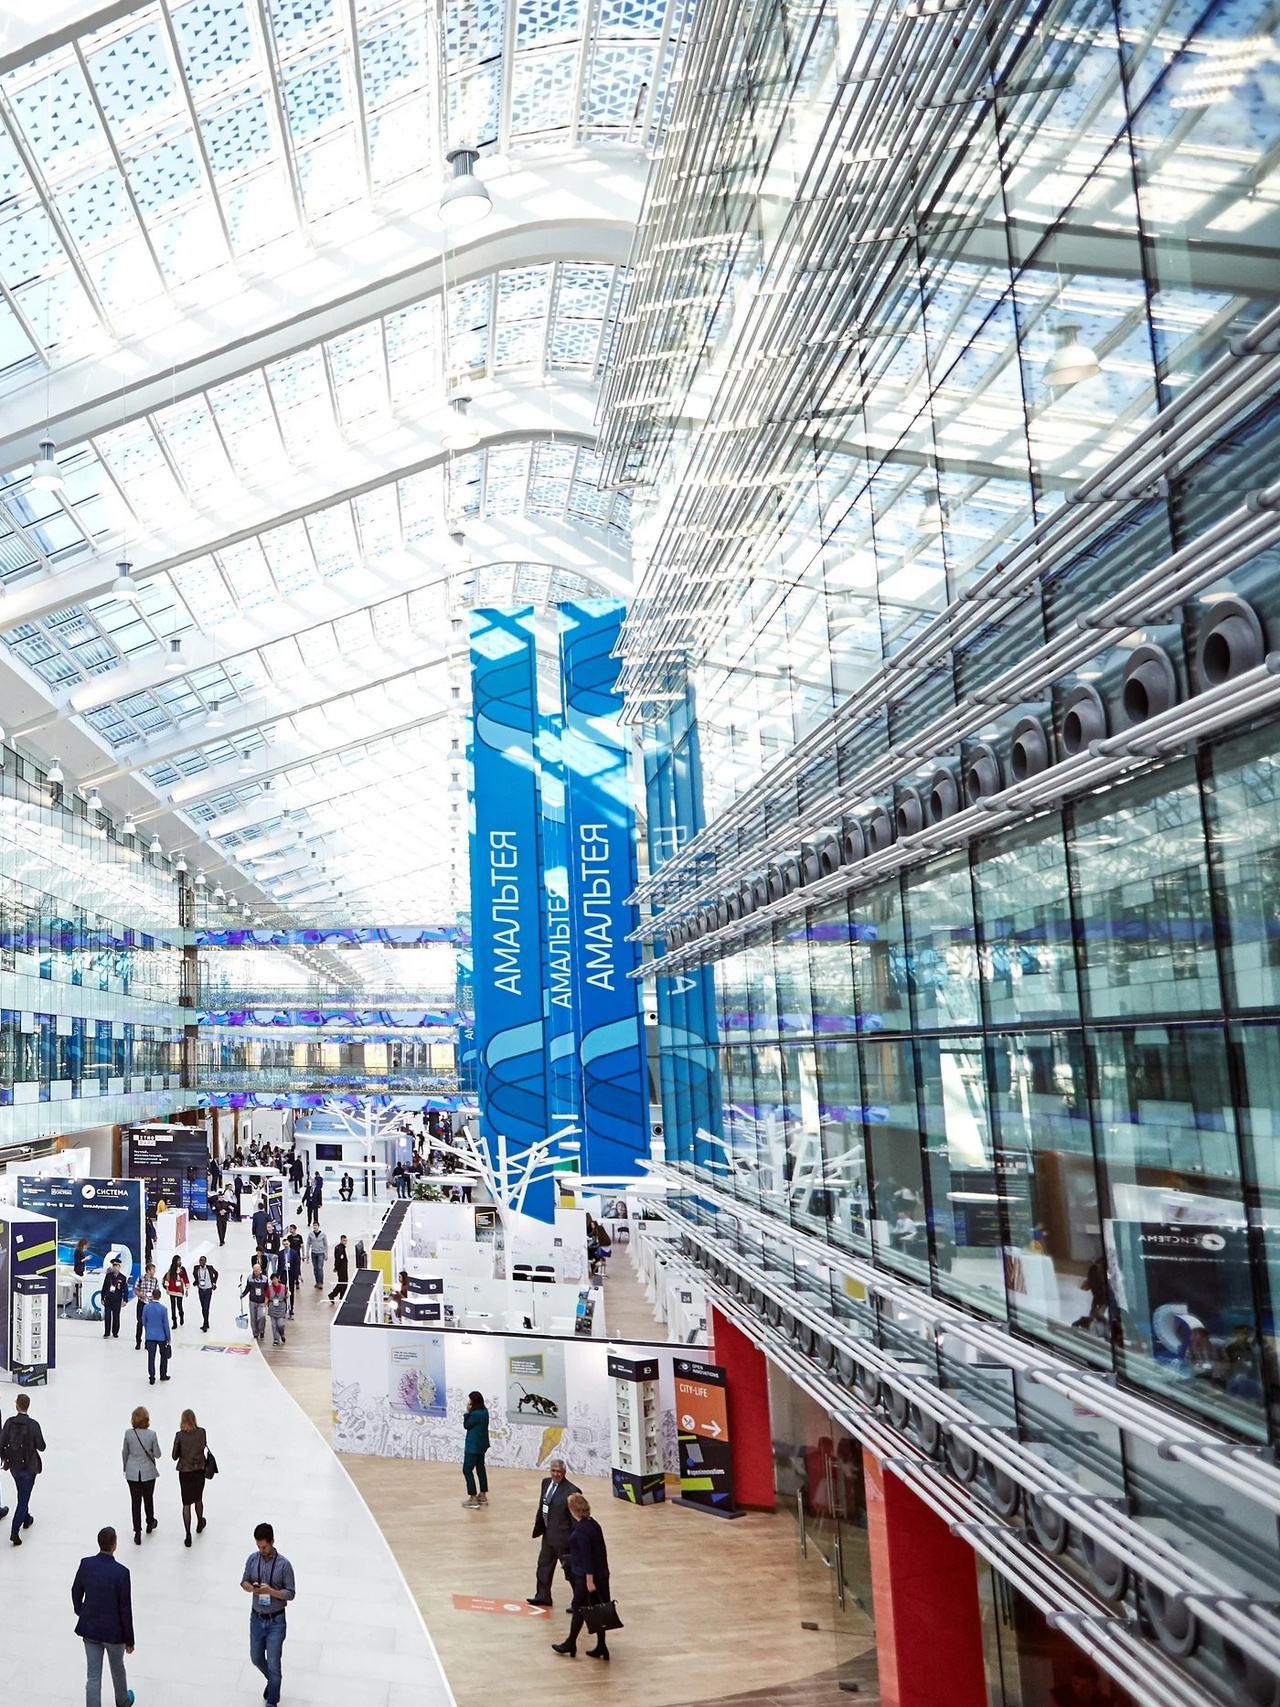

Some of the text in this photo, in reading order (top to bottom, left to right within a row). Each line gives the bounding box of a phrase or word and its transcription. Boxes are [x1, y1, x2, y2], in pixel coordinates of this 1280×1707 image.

[489, 831, 522, 995] АМАЛЬТЕЯ
[579, 824, 615, 991] АМАЛЬТЕЯ
[96, 1188, 129, 1196] СИСТЕМА
[691, 1363, 704, 1371] OPEN
[679, 1383, 708, 1398] CITY-LIFE
